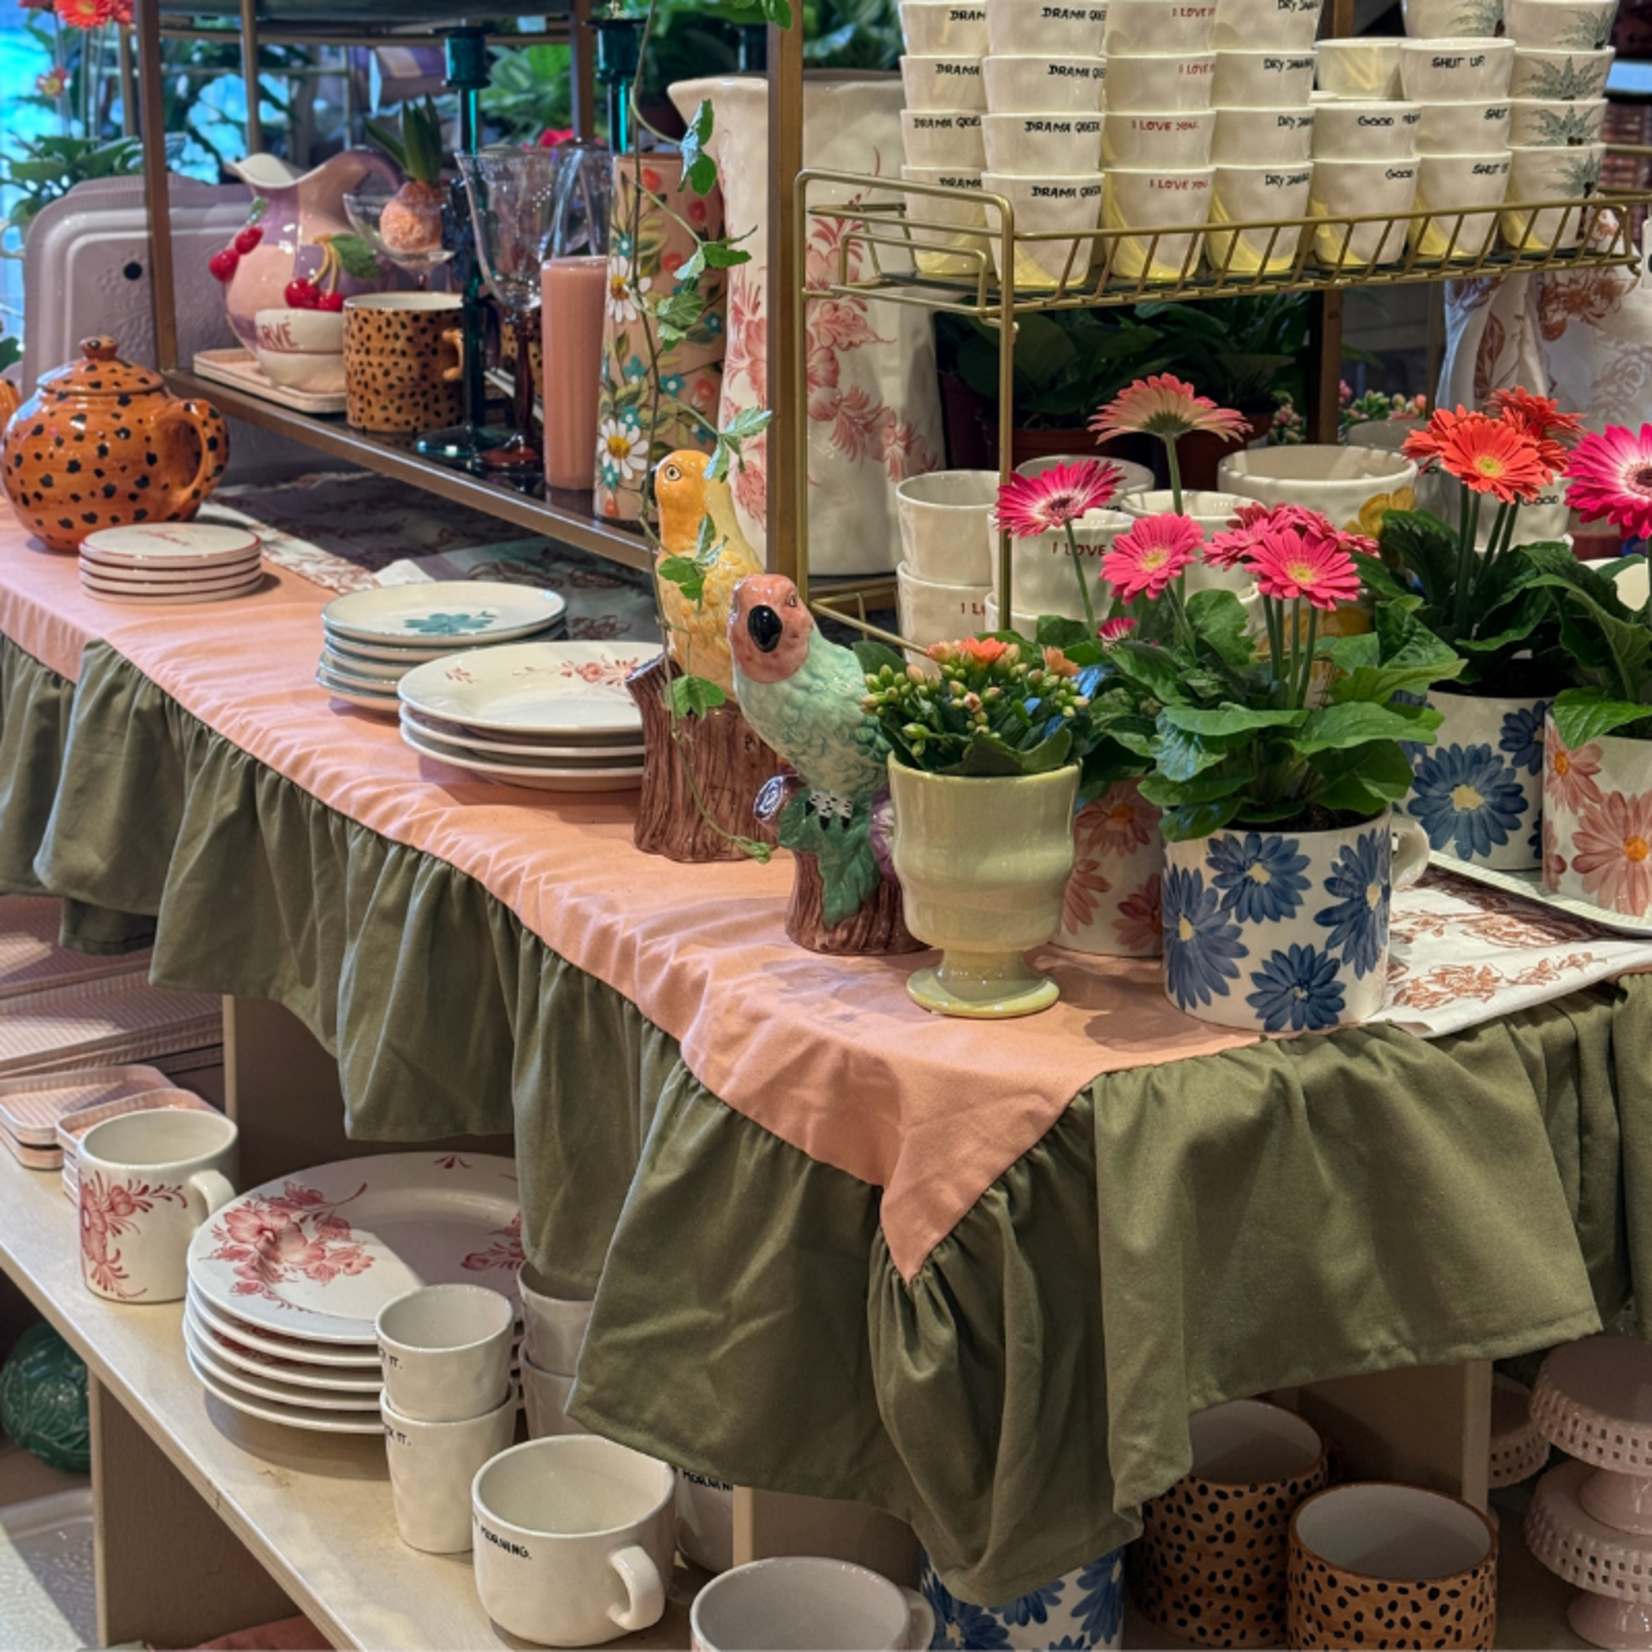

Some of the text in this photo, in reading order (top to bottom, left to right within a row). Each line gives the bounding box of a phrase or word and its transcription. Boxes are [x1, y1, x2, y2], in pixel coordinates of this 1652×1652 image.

[1180, 7, 1206, 17] LOVE
[1431, 56, 1465, 69] SHUT
[936, 63, 980, 76] DRAMA
[914, 117, 953, 129] DRAMA
[1131, 120, 1136, 129] I
[1140, 120, 1172, 131] LOVE
[1358, 115, 1394, 126] GOOD
[1024, 121, 1070, 133] DRAMA
[1472, 162, 1500, 175] SHUT
[1149, 179, 1154, 188] I
[1158, 179, 1189, 190] LOVE
[1031, 186, 1076, 198] DRAMA
[1053, 541, 1058, 554] I
[1064, 543, 1107, 557] LOVE
